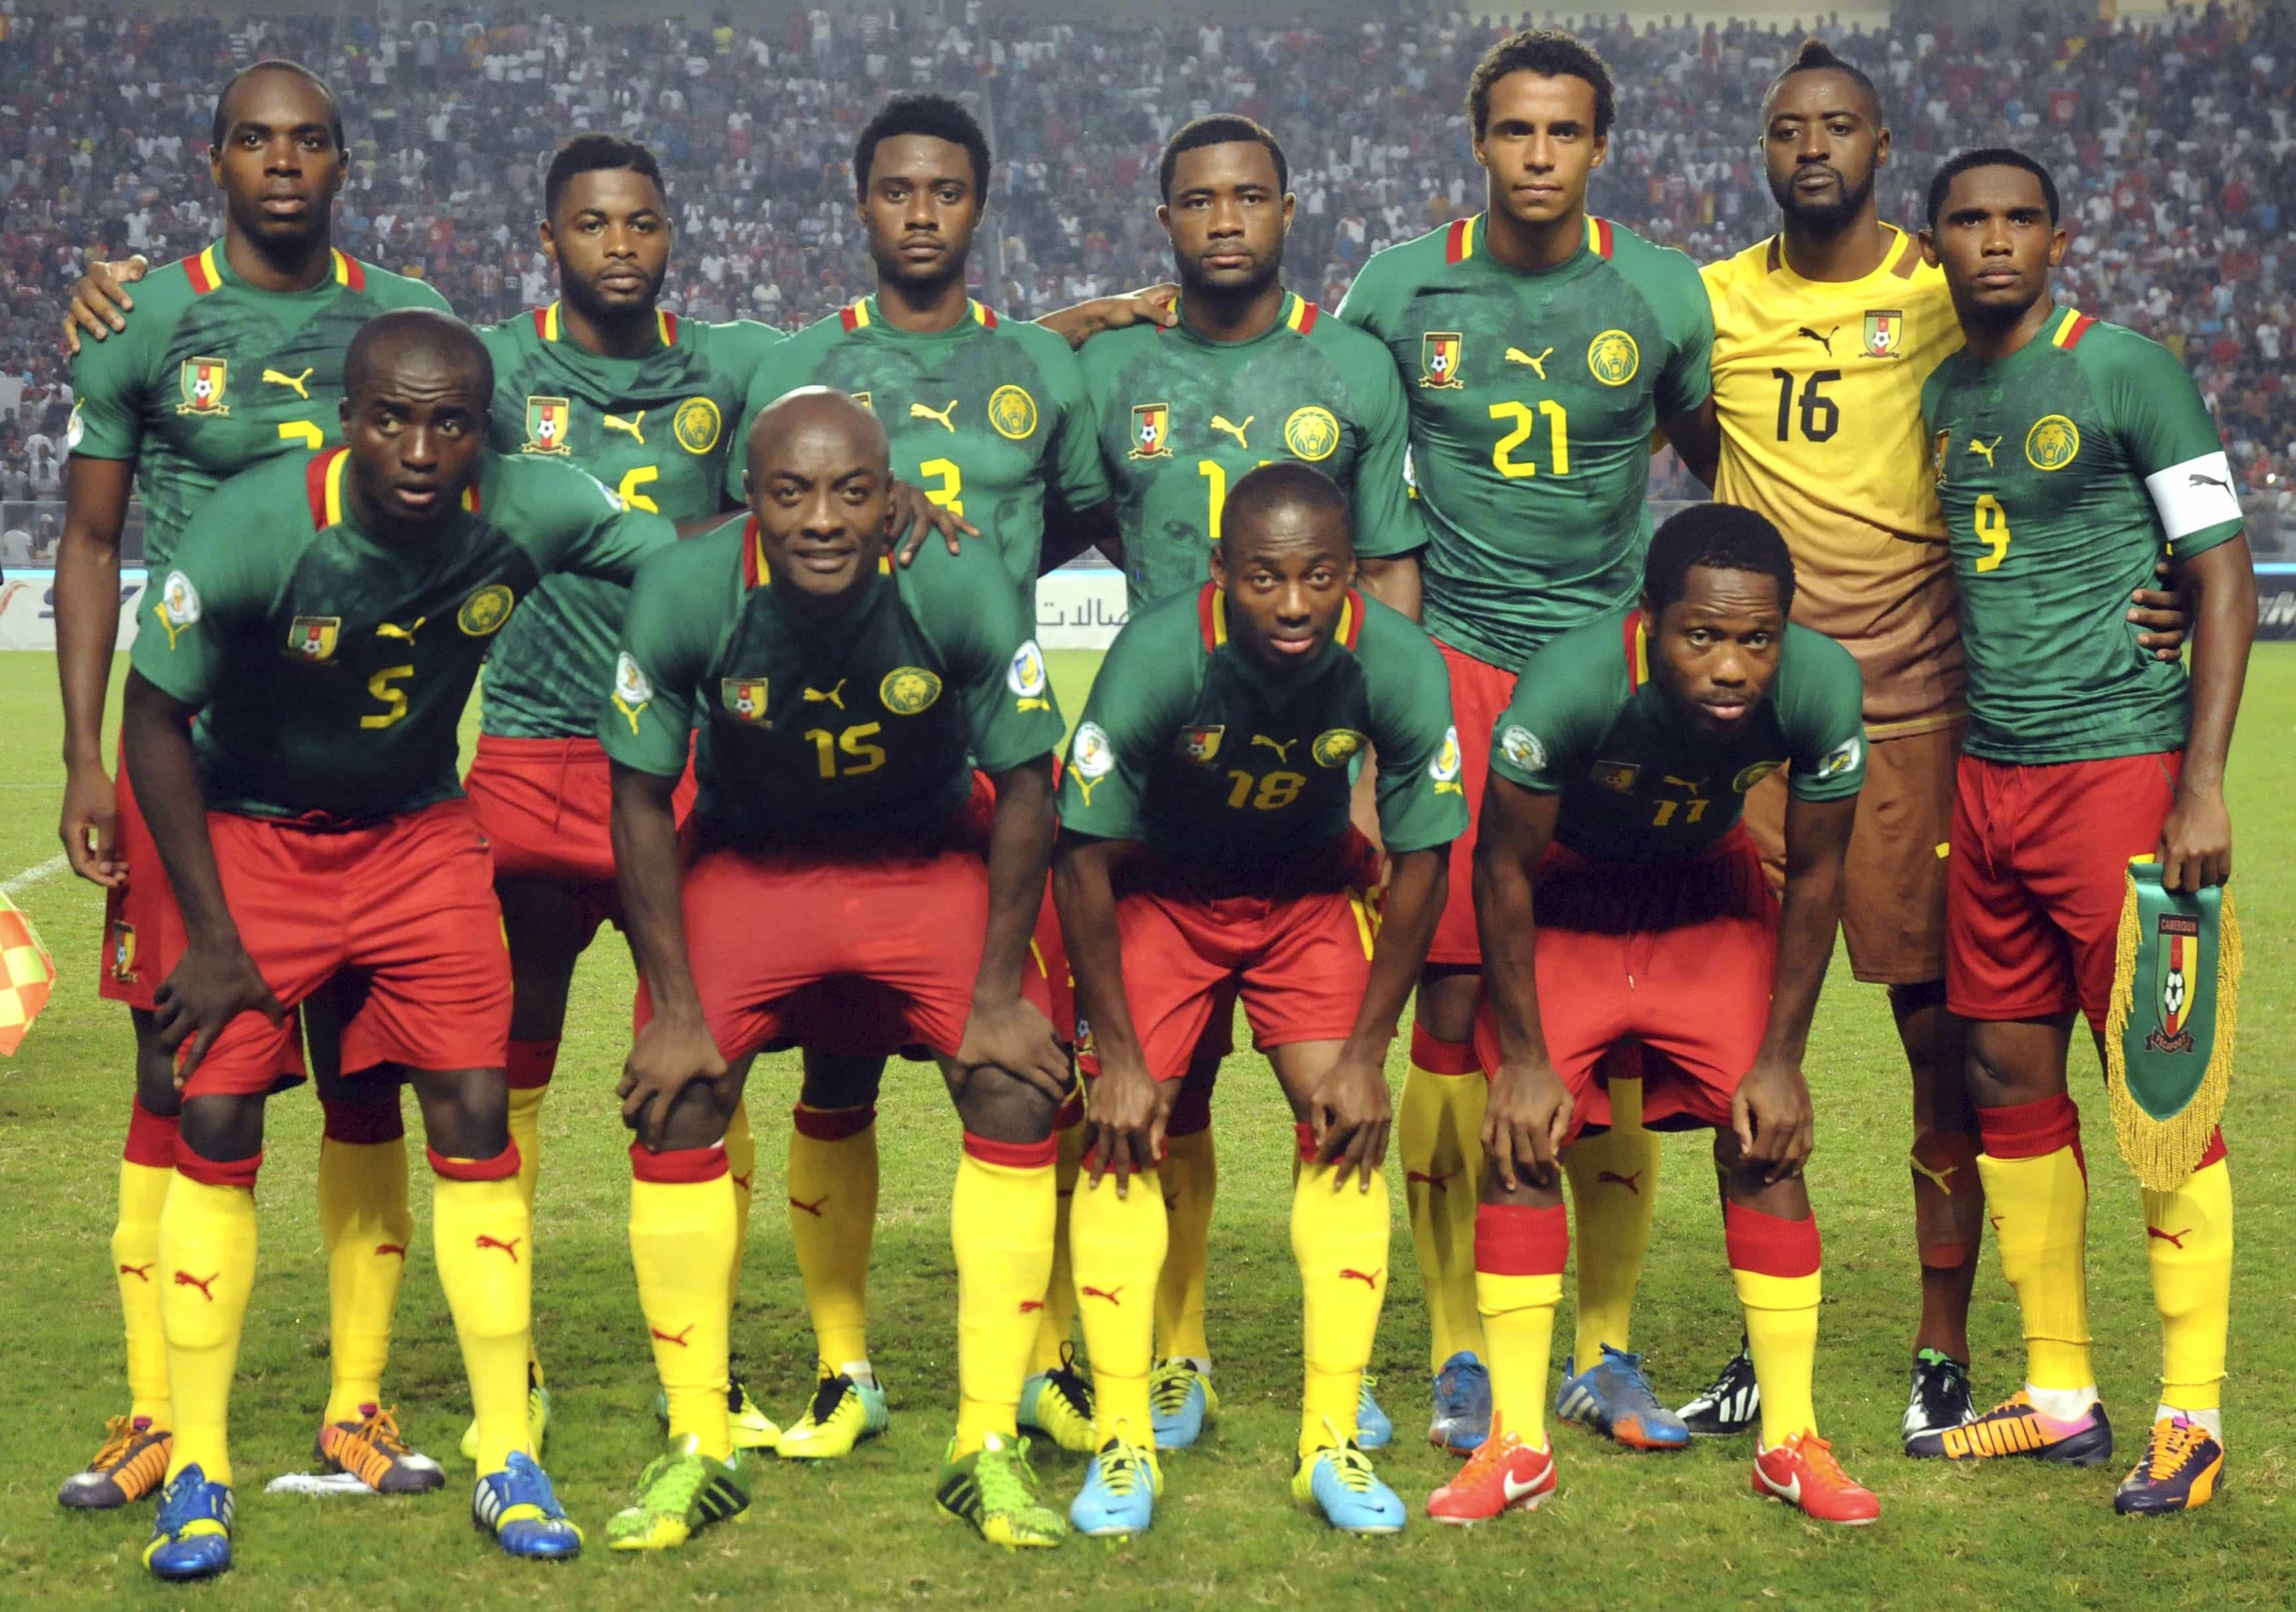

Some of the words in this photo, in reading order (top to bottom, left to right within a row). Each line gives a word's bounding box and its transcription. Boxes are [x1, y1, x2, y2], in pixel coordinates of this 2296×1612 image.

[1771, 367, 1841, 443] 16
[1489, 399, 1569, 477] 21
[1198, 460, 1273, 538] 1
[1974, 494, 2011, 573] 9
[360, 664, 414, 729] 5
[804, 721, 886, 778] 15
[1228, 769, 1307, 810] 18
[1651, 799, 1710, 826] 11
[1941, 1412, 2049, 1459] PUMA
